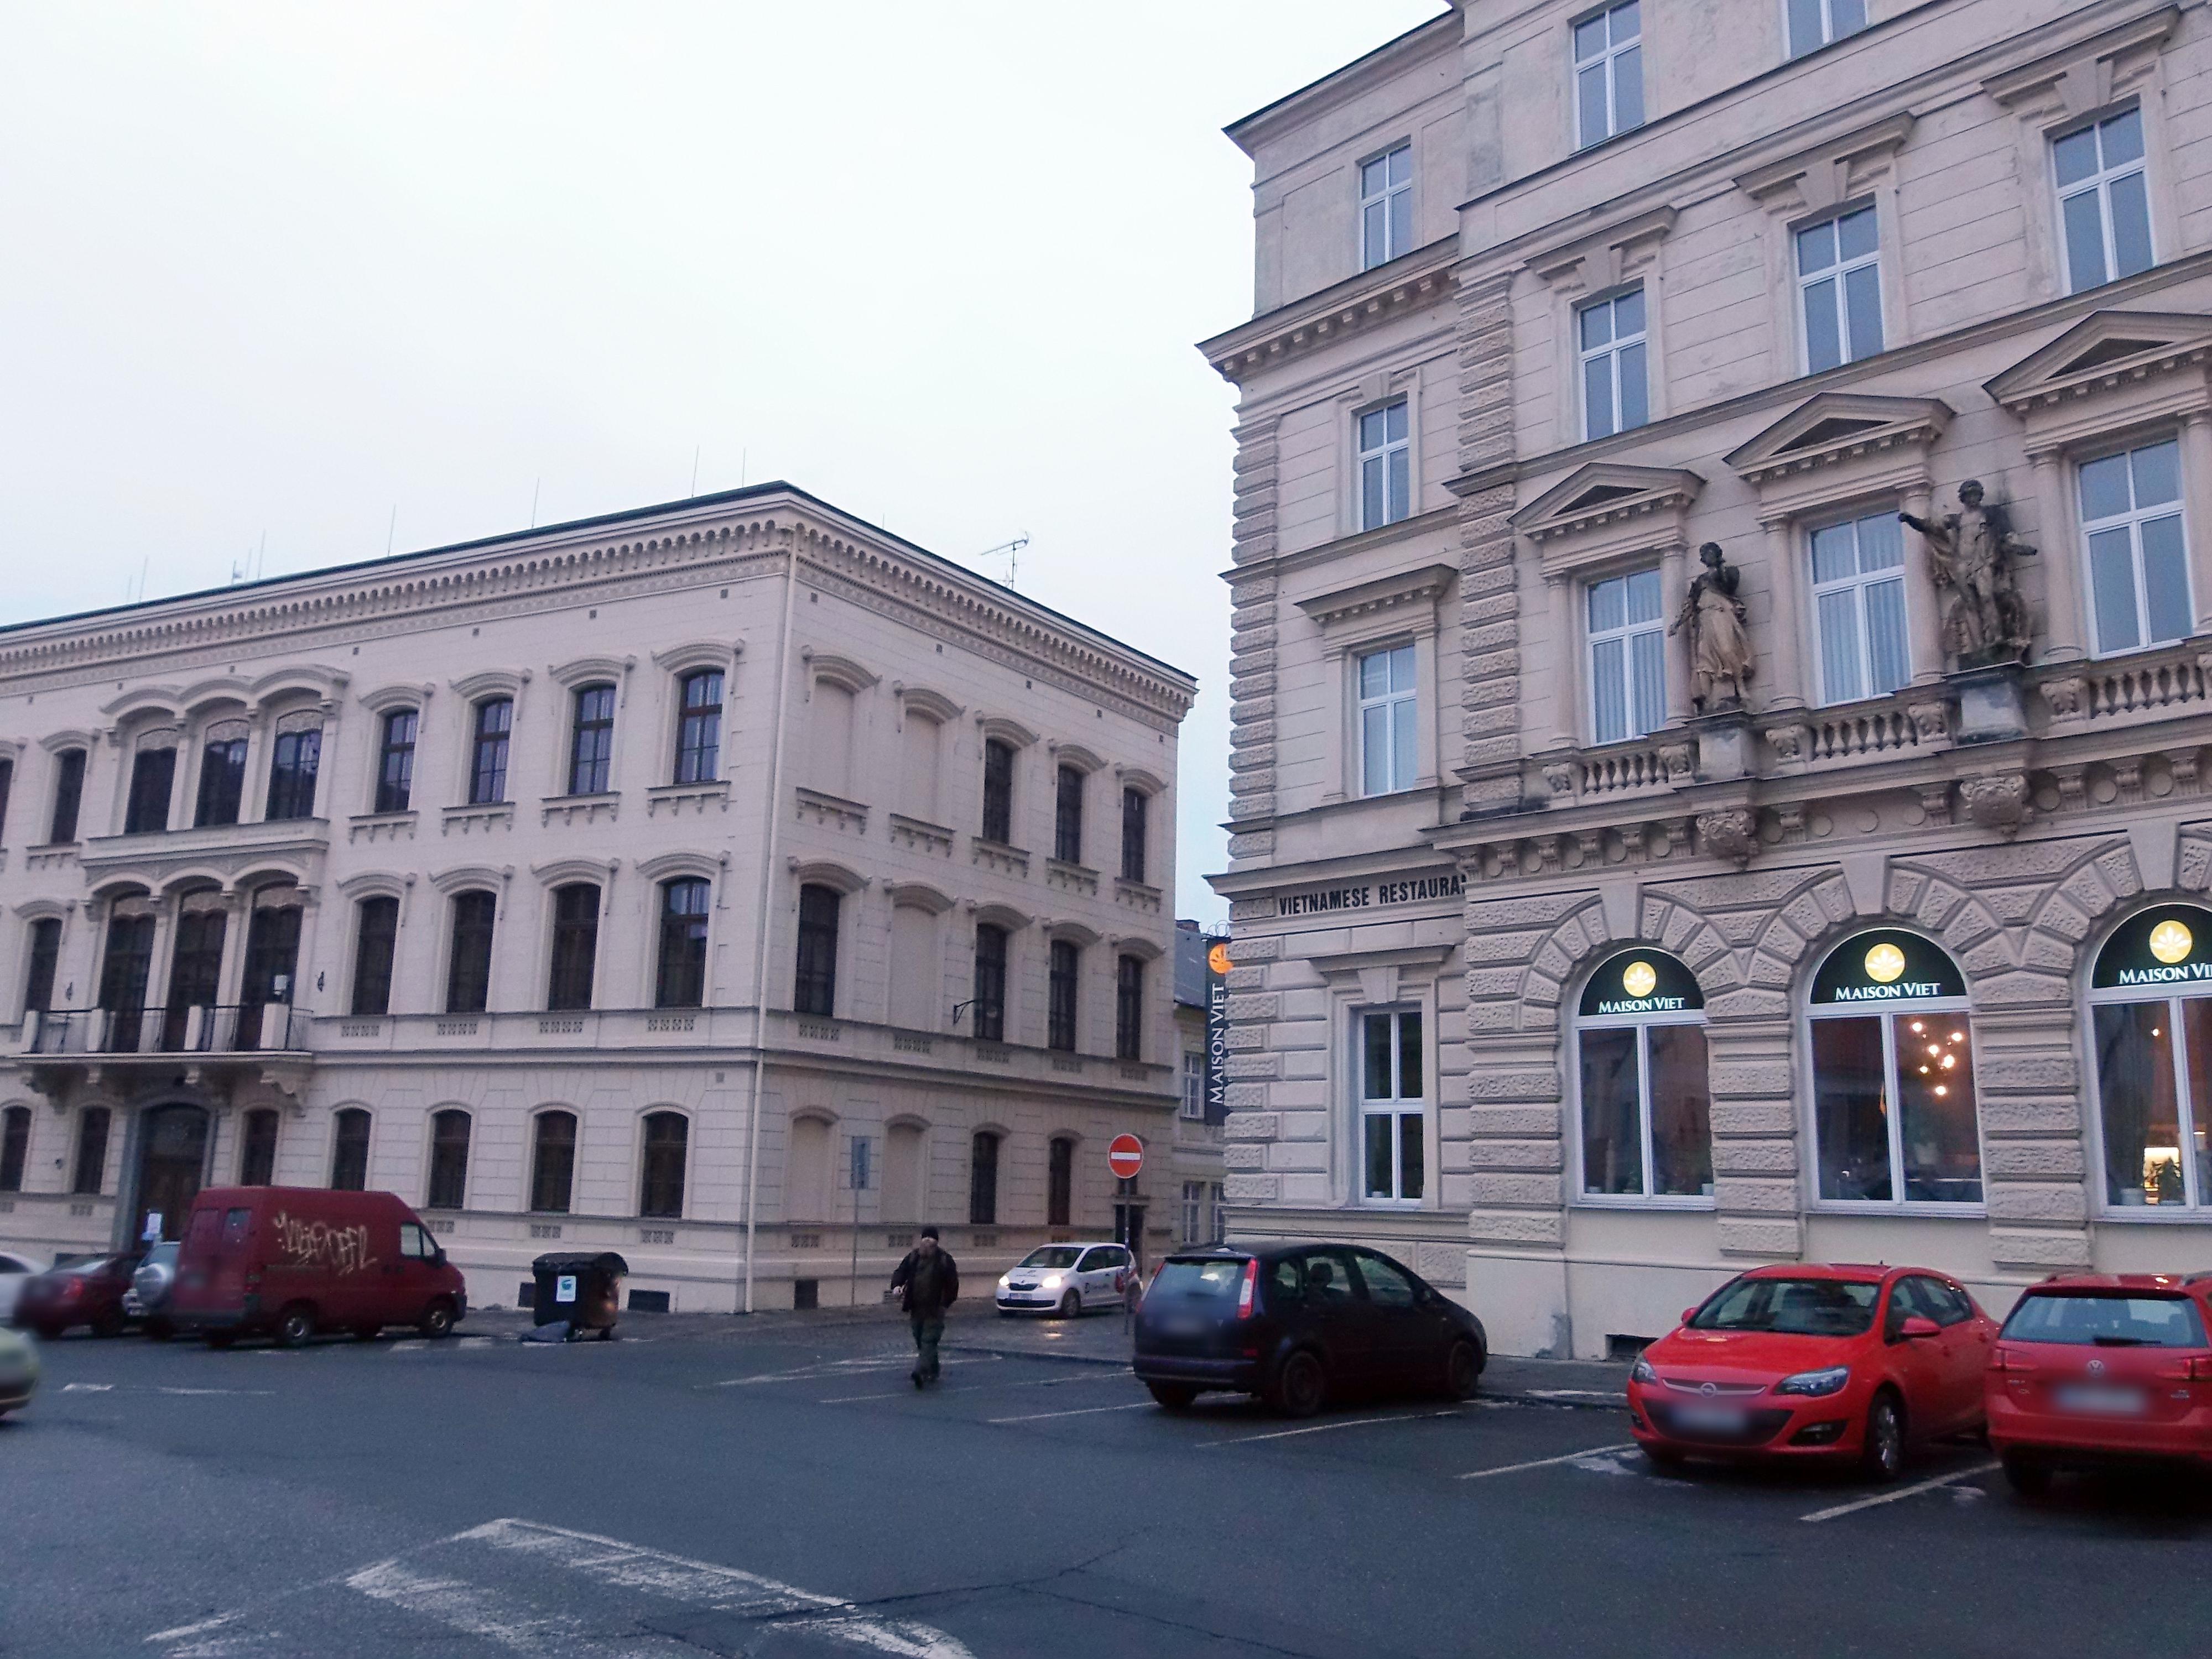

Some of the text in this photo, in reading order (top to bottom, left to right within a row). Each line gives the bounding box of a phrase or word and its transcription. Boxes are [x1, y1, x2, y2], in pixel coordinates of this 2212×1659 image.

[1279, 887, 1370, 915] VIETNAMESE
[2119, 966, 2188, 984] MAISON
[1835, 982, 1940, 1000] MAISON VIET
[1598, 997, 1685, 1014] MAISON VIET
[1210, 983, 1224, 1104] MAISON VIET
